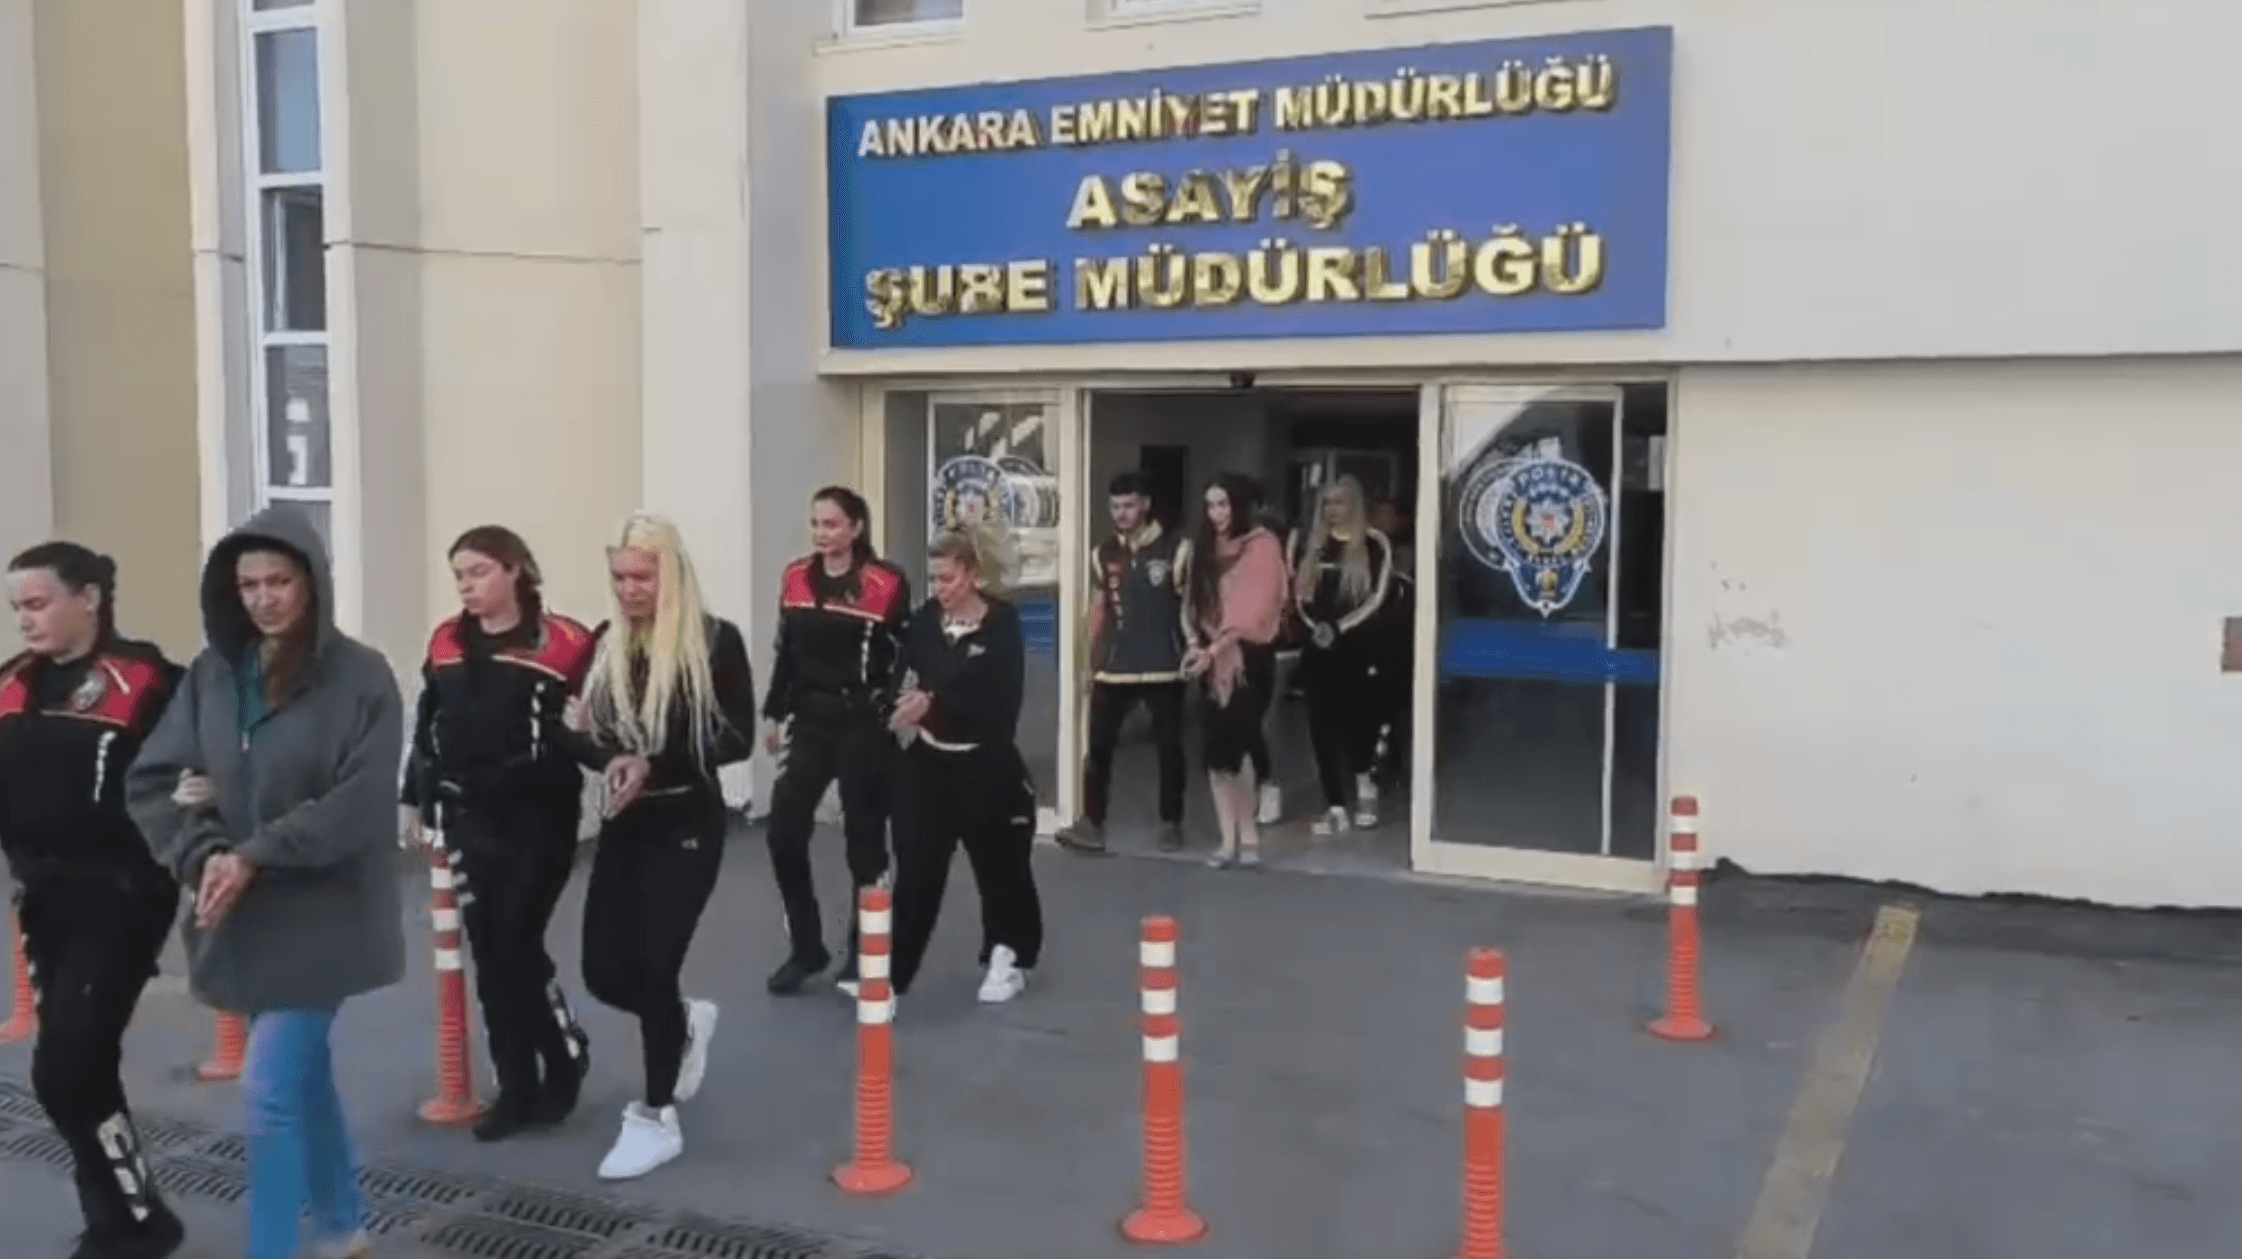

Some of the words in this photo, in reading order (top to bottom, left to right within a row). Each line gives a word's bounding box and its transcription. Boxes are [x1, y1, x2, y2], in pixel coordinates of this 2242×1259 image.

[858, 108, 1039, 157] ANKARA
[1050, 86, 1260, 145] EMNİYET
[1274, 54, 1613, 130] MÜDÜRLÜĞÜ
[1066, 148, 1351, 229] ASAYİŞ
[865, 257, 1050, 329] ŞUBE
[1074, 222, 1602, 310] MÜDÜRLÜĞÜ
